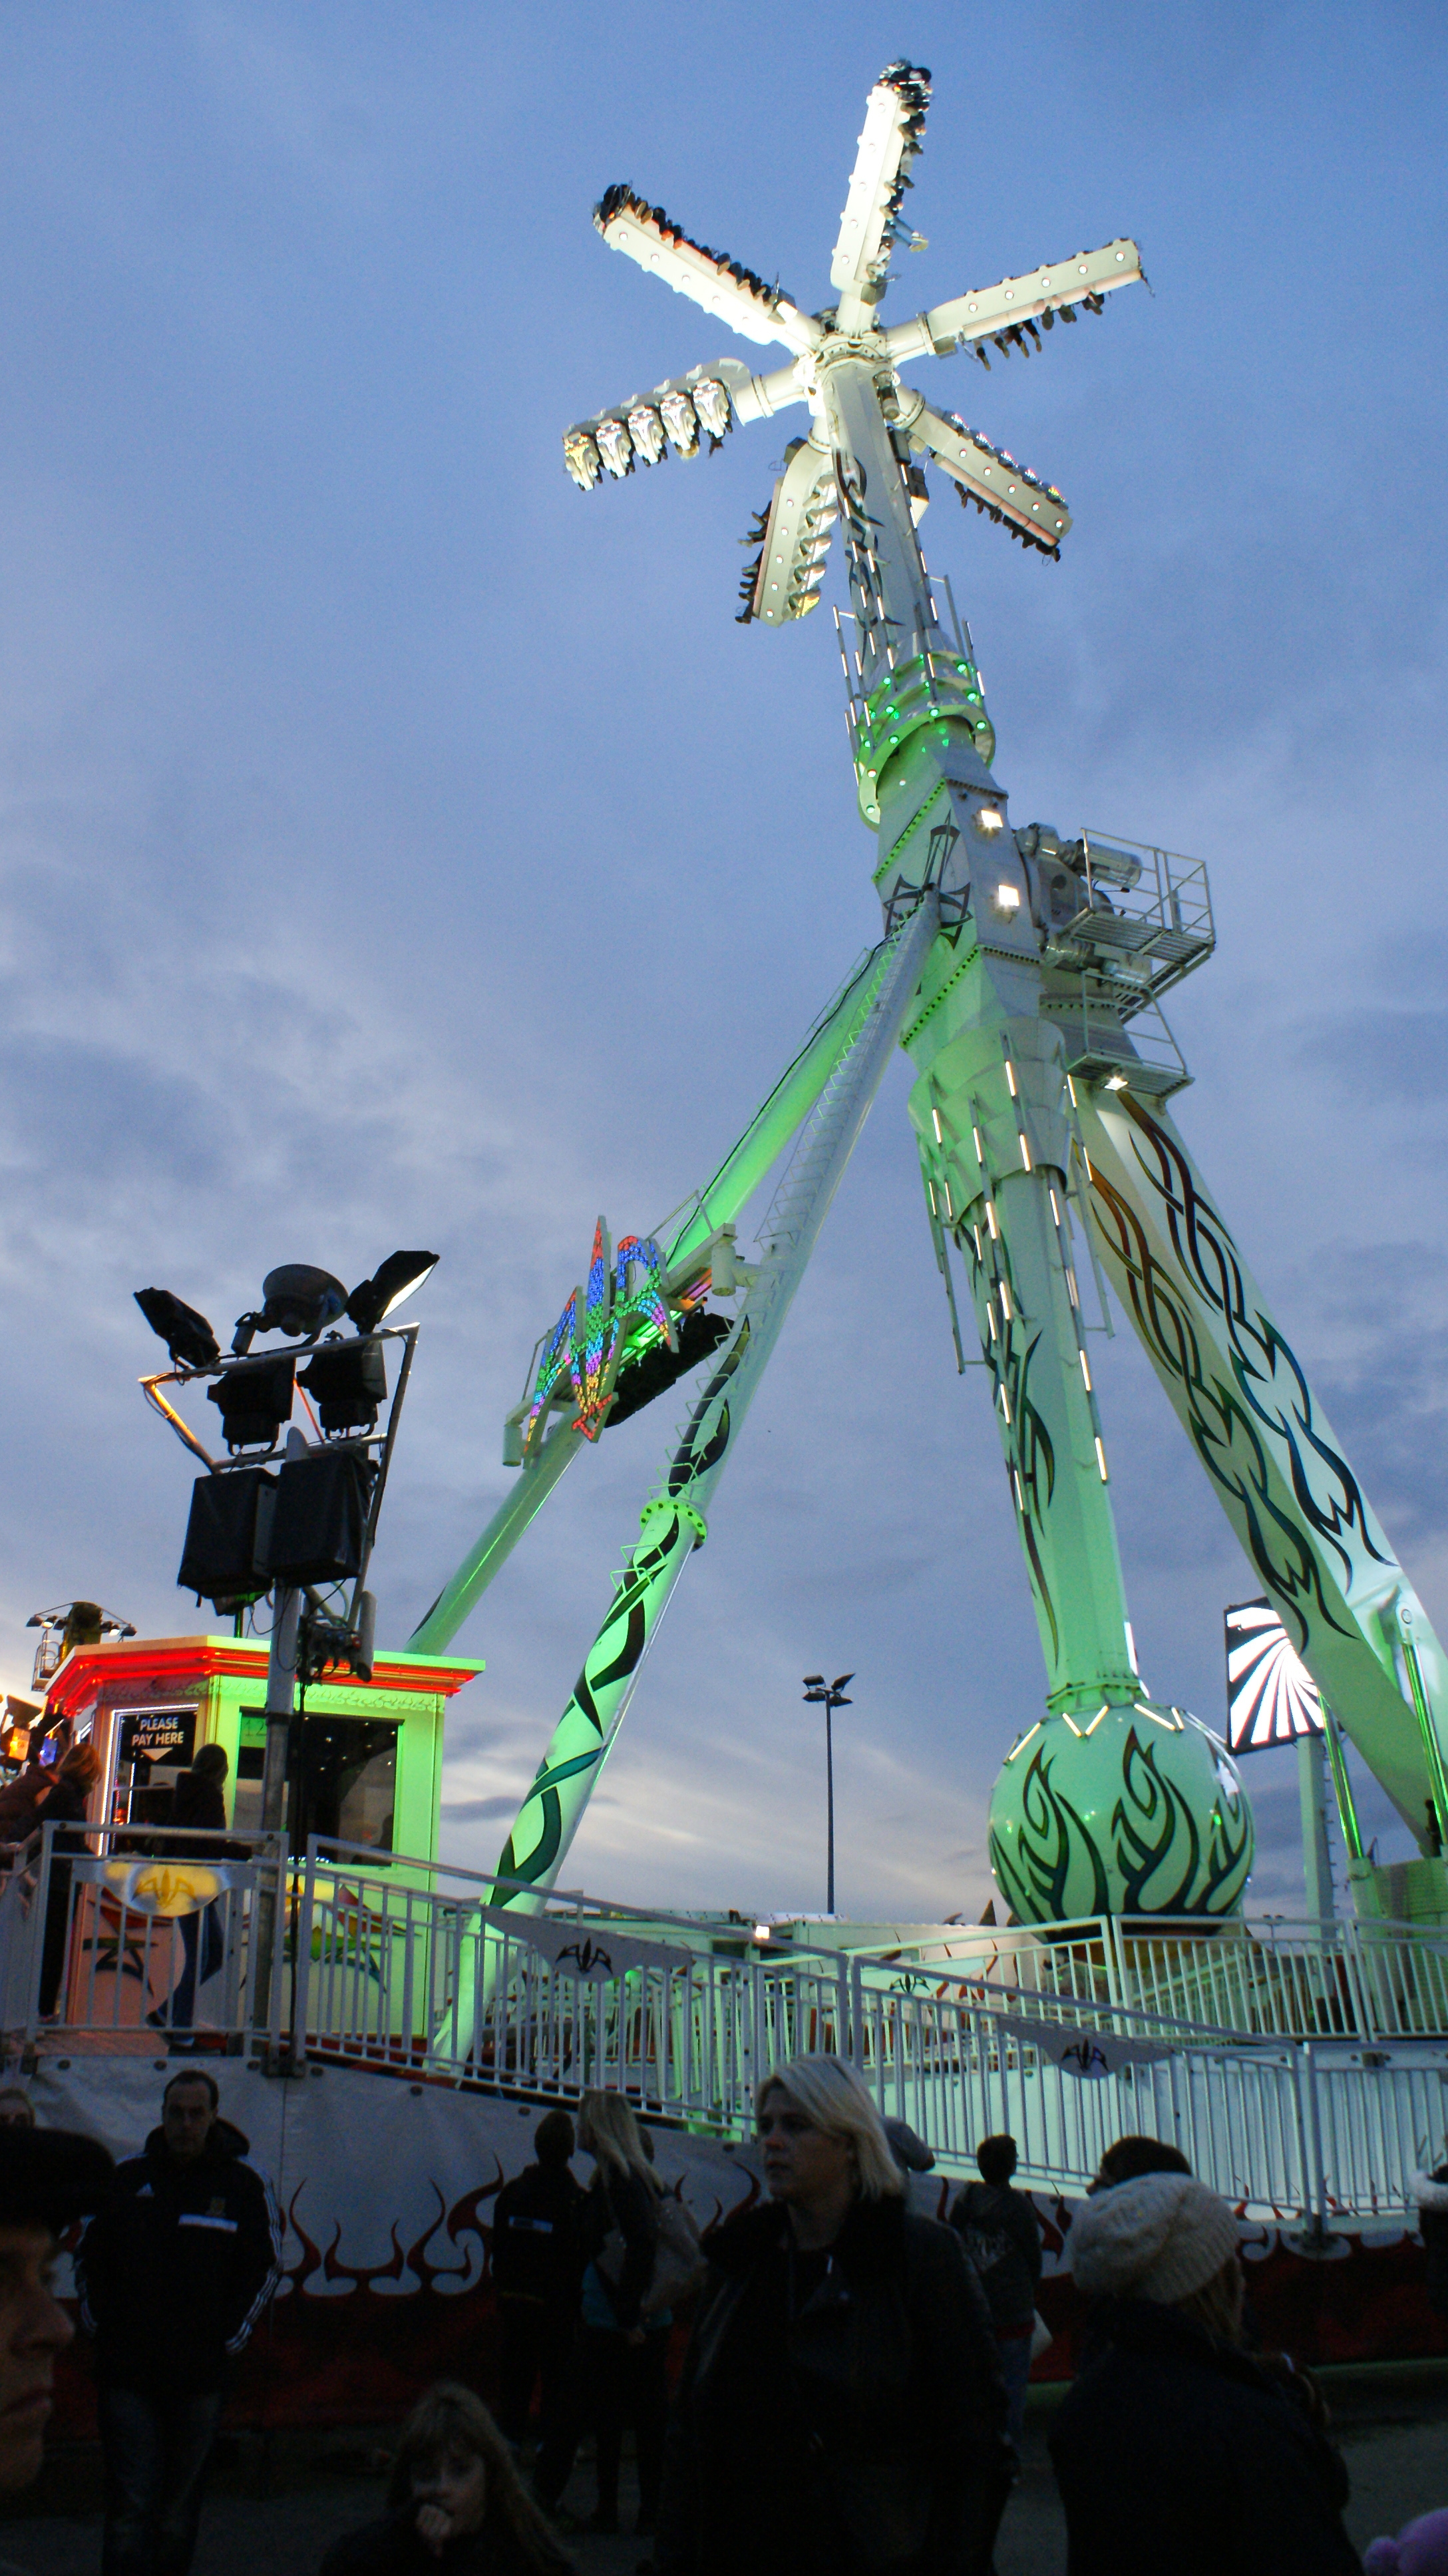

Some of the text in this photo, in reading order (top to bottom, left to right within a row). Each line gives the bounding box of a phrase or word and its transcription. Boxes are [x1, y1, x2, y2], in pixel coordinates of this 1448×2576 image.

[140, 1716, 179, 1731] PLEASE
[132, 1731, 184, 1746] PAY HERE
